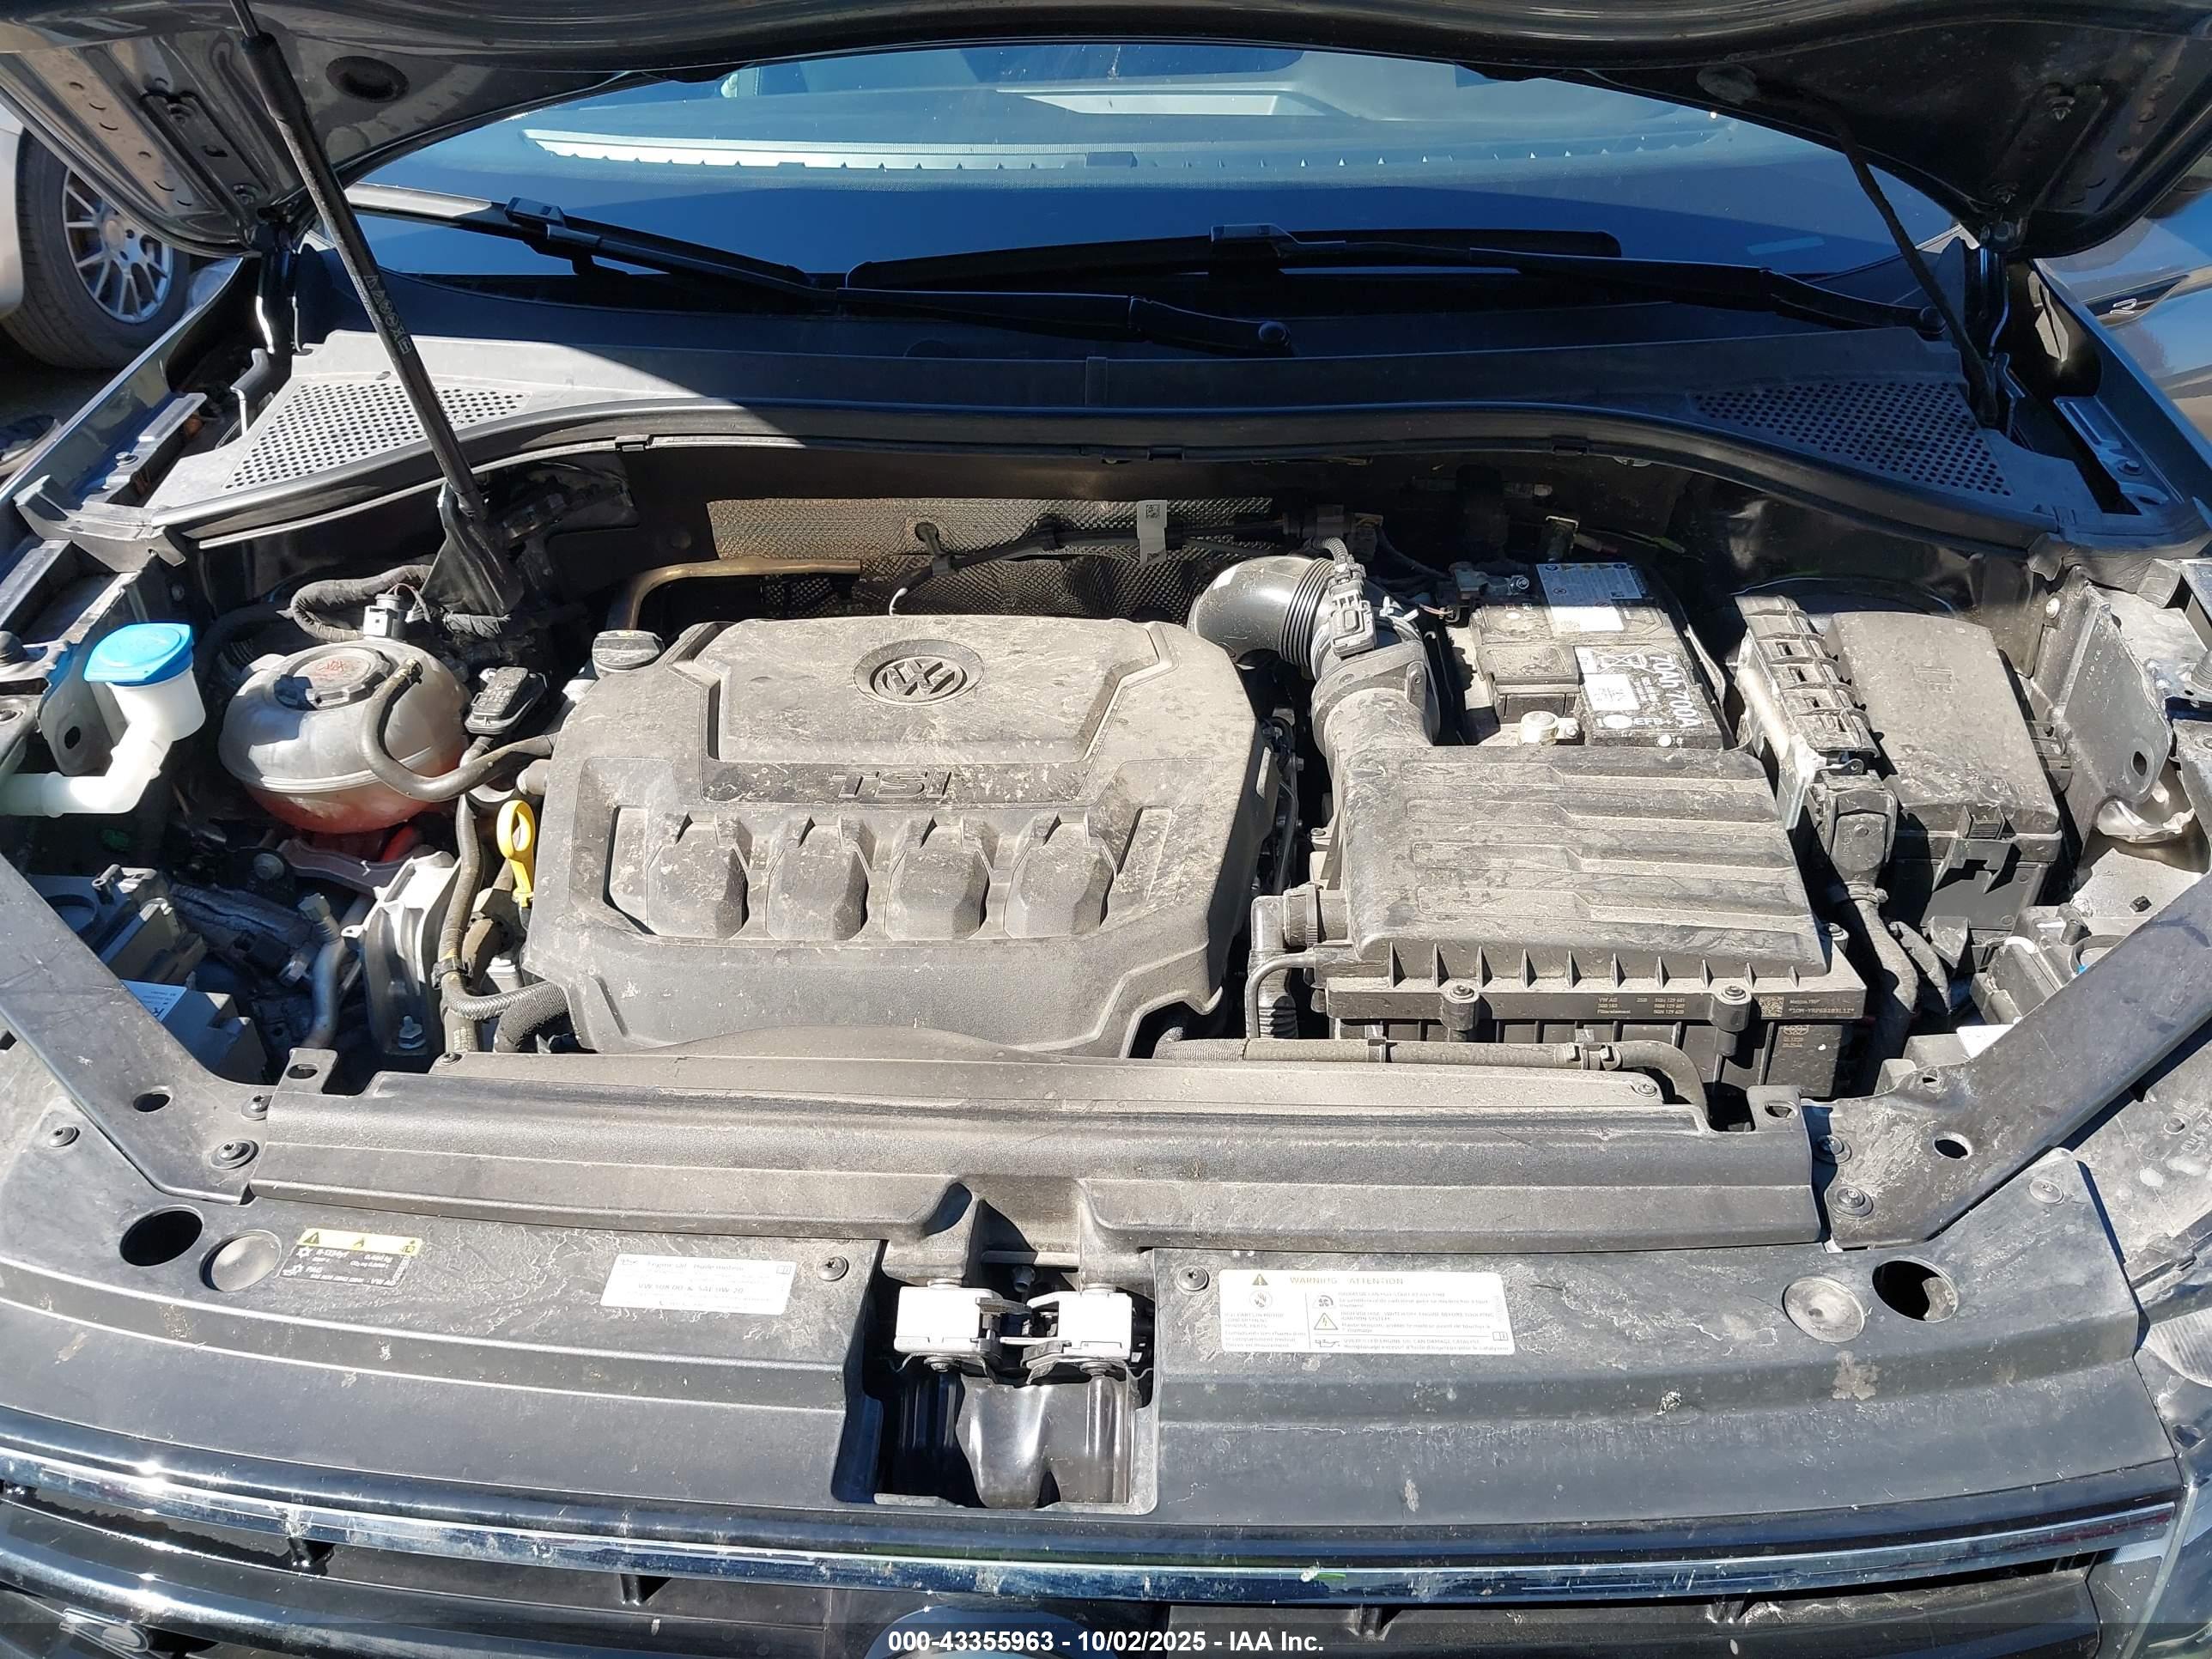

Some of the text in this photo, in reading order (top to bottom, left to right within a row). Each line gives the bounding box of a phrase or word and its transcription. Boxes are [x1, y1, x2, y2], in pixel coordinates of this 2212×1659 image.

[1650, 654, 1703, 728] 70Ah 700A
[830, 769, 953, 799] TSI
